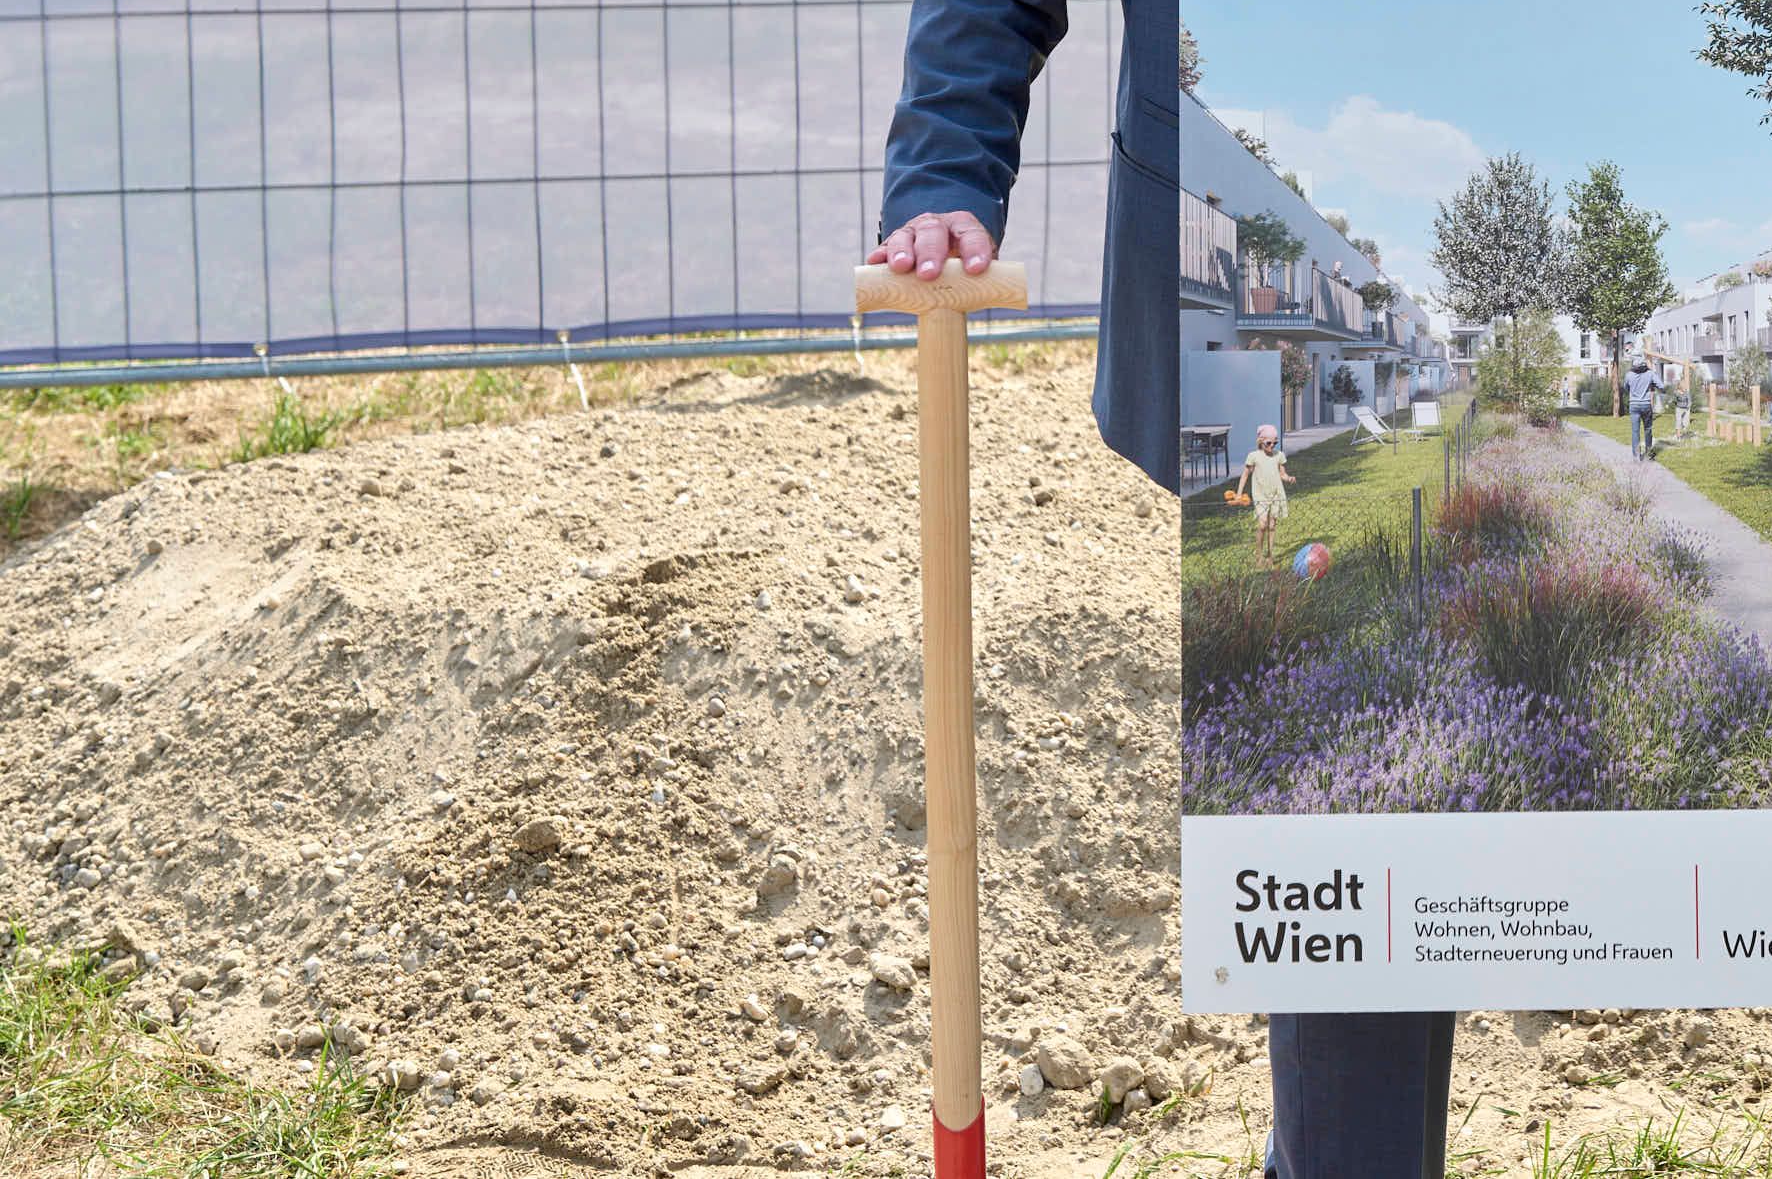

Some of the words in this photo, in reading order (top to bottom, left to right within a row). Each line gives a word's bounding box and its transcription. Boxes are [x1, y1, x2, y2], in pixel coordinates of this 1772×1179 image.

[1235, 868, 1364, 913] Stadt
[1414, 895, 1569, 918] Geschäftsgruppe
[1414, 920, 1495, 941] Wohnen,
[1500, 919, 1593, 939] Wohnbau,
[1234, 921, 1363, 964] Wien
[1415, 944, 1568, 966] Stadterneuerung
[1573, 943, 1607, 960] und
[1612, 943, 1673, 960] Frauen
